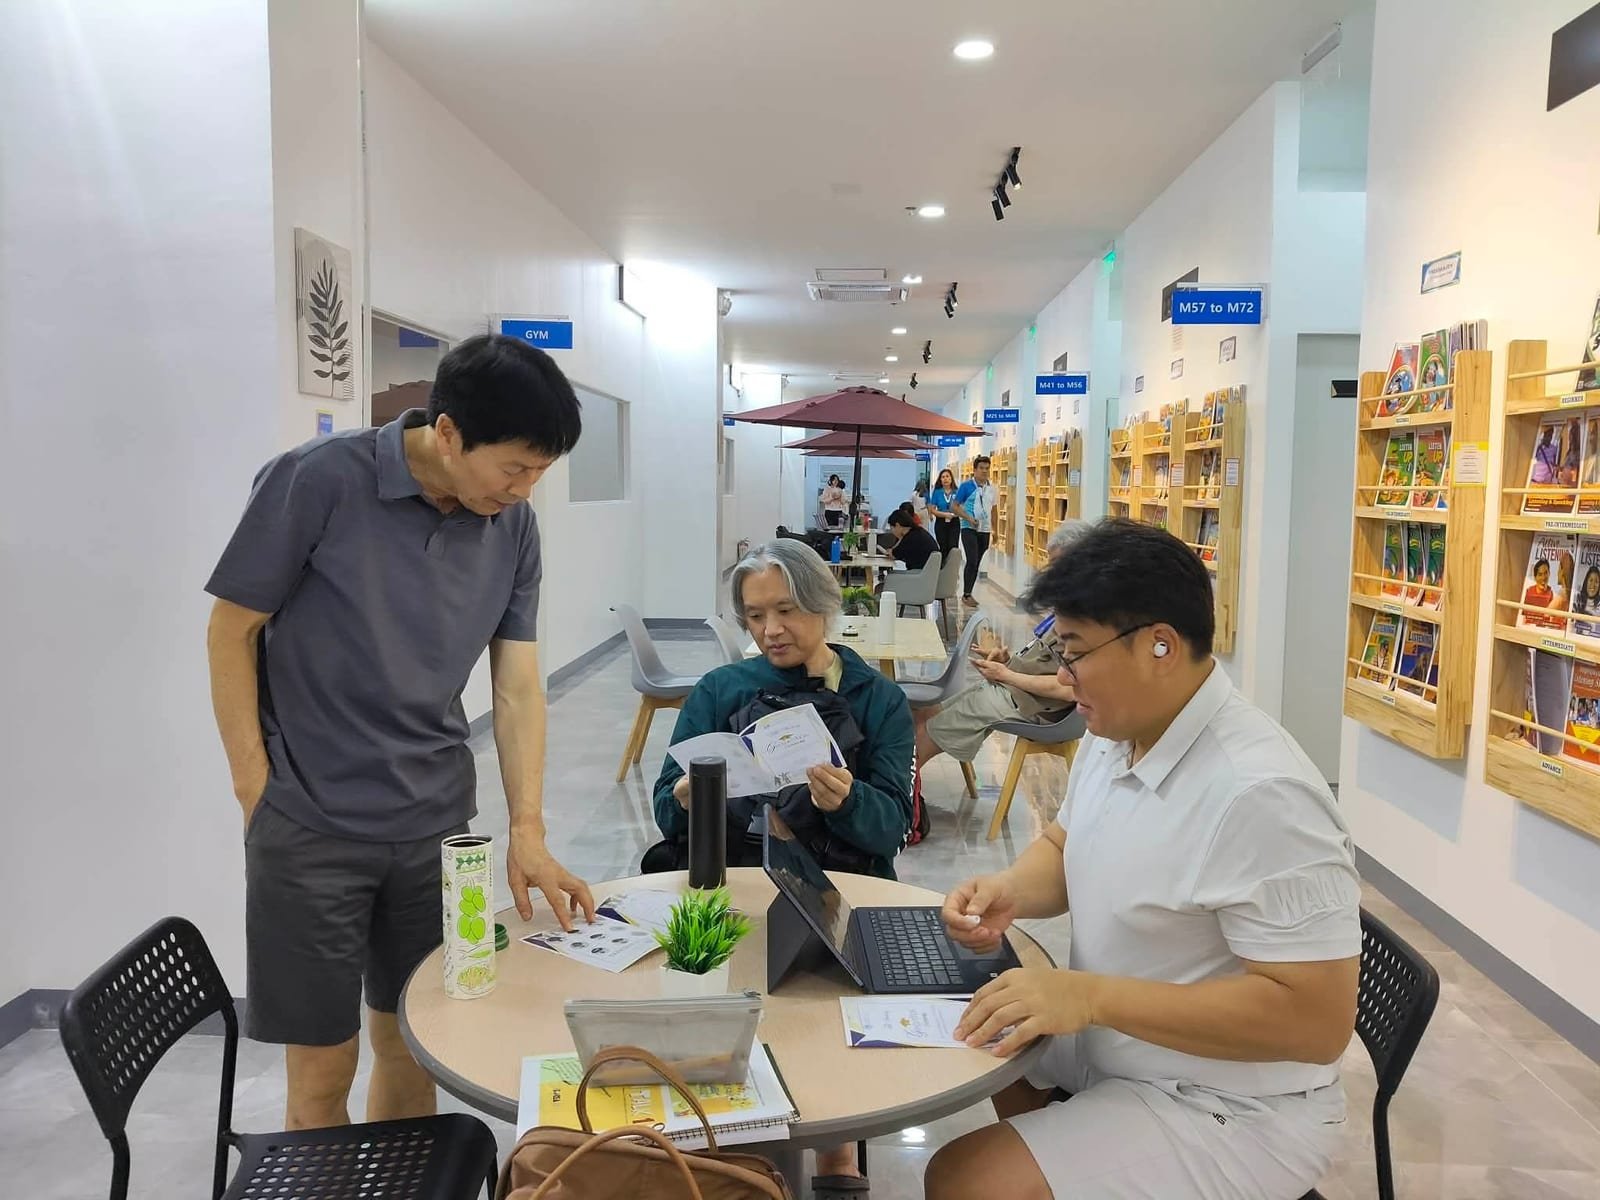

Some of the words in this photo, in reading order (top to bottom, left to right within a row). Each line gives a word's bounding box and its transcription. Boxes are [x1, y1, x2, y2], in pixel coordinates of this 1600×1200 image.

[1179, 302, 1206, 313] M57
[1210, 303, 1223, 313] to
[1227, 302, 1254, 313] M72
[525, 330, 549, 339] GYM
[1039, 381, 1055, 389] M41
[1066, 381, 1083, 389] M56
